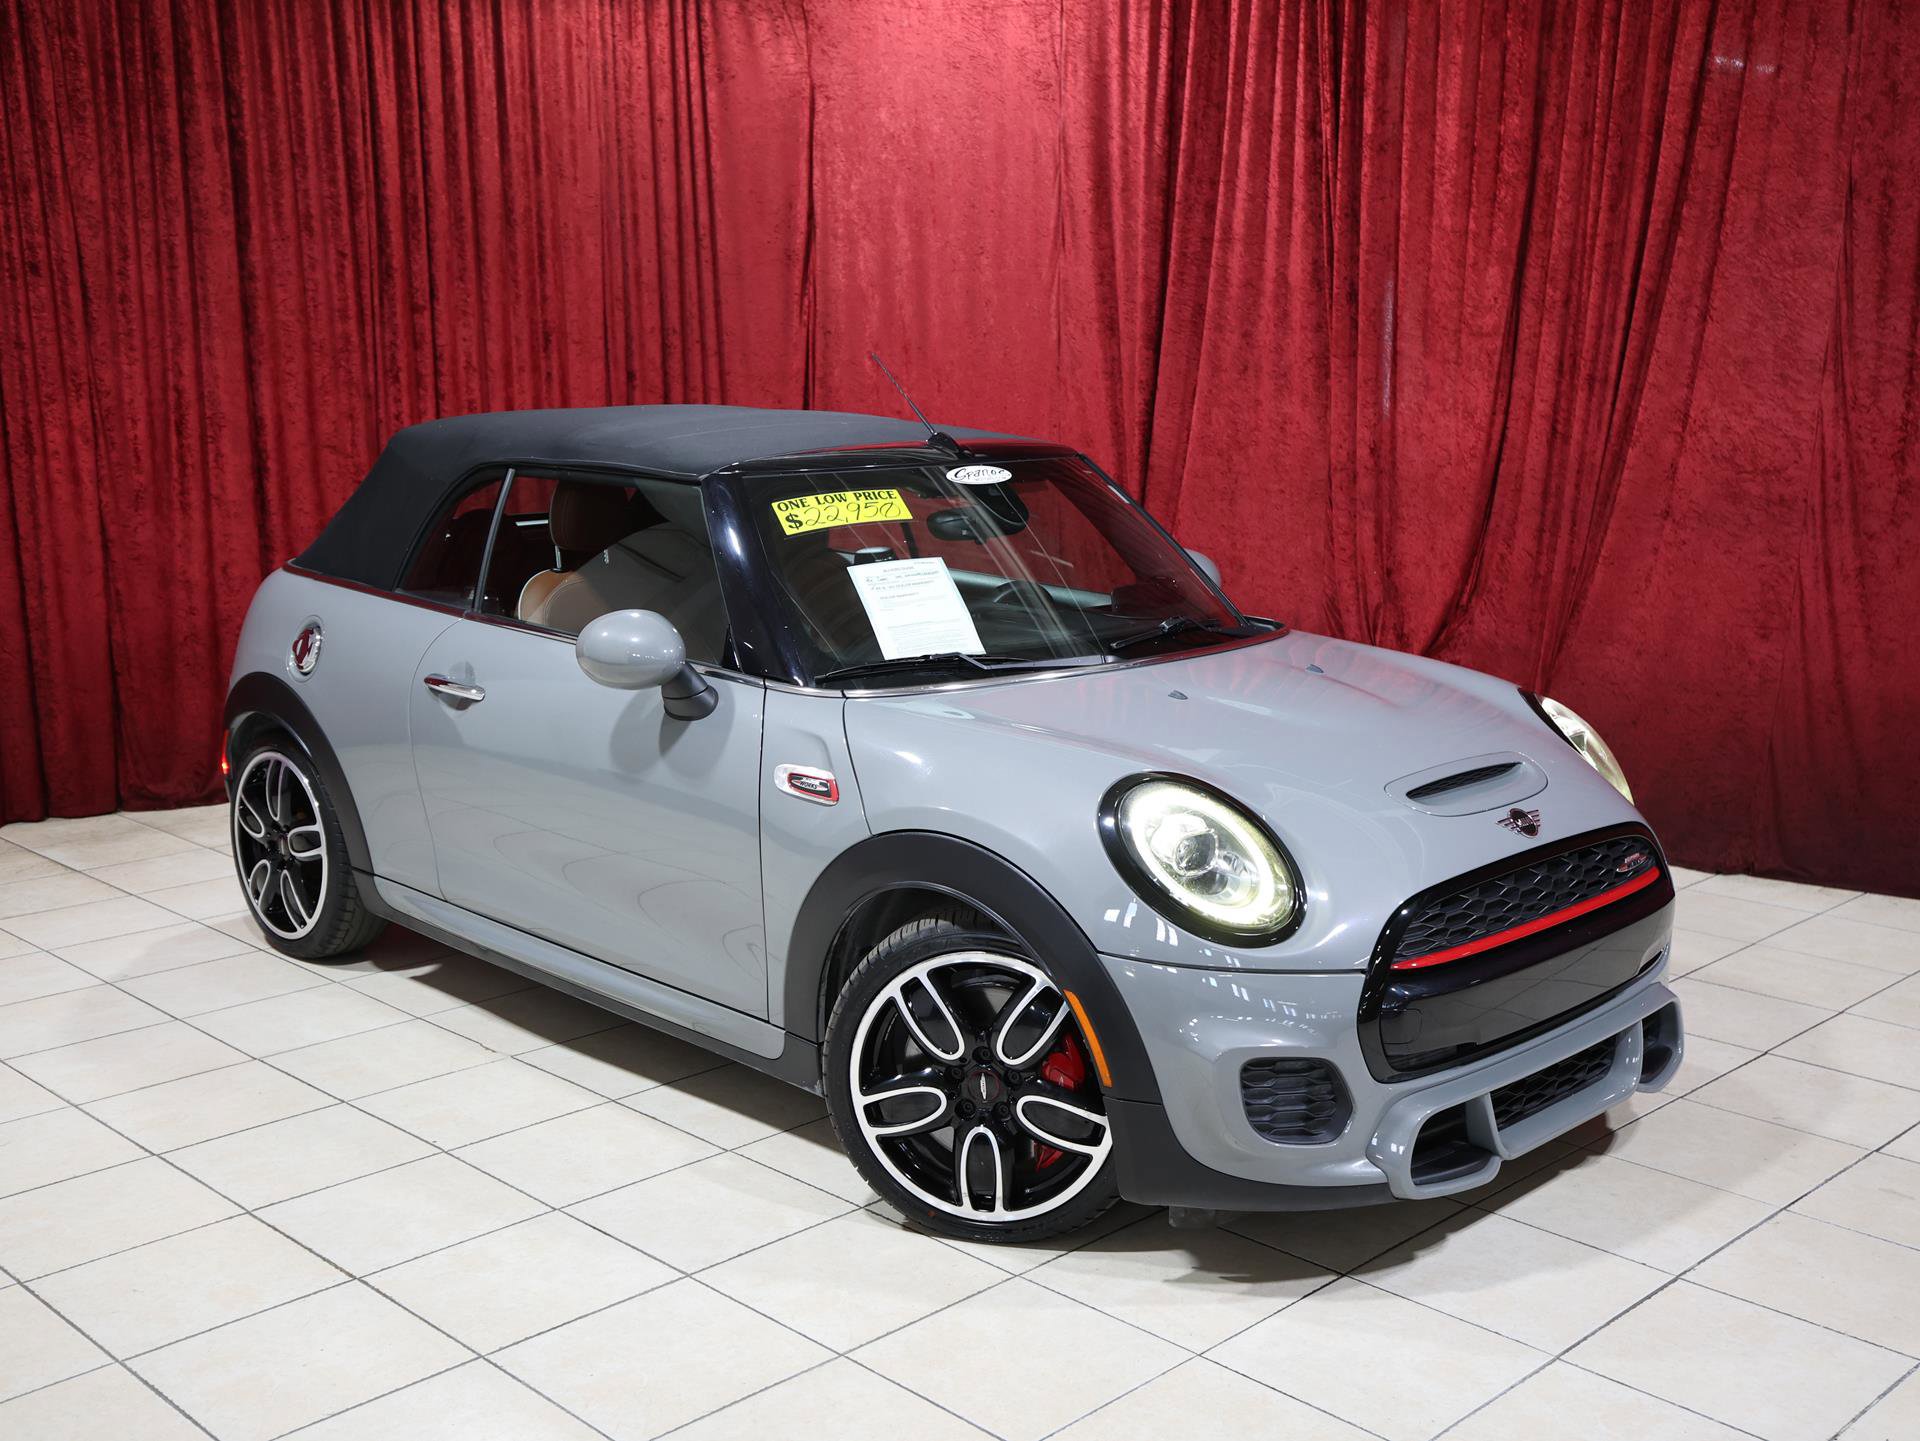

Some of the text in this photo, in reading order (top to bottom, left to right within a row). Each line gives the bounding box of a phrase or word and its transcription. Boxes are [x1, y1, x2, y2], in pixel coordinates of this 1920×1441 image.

[777, 490, 897, 512] ONE LOW PRICE
